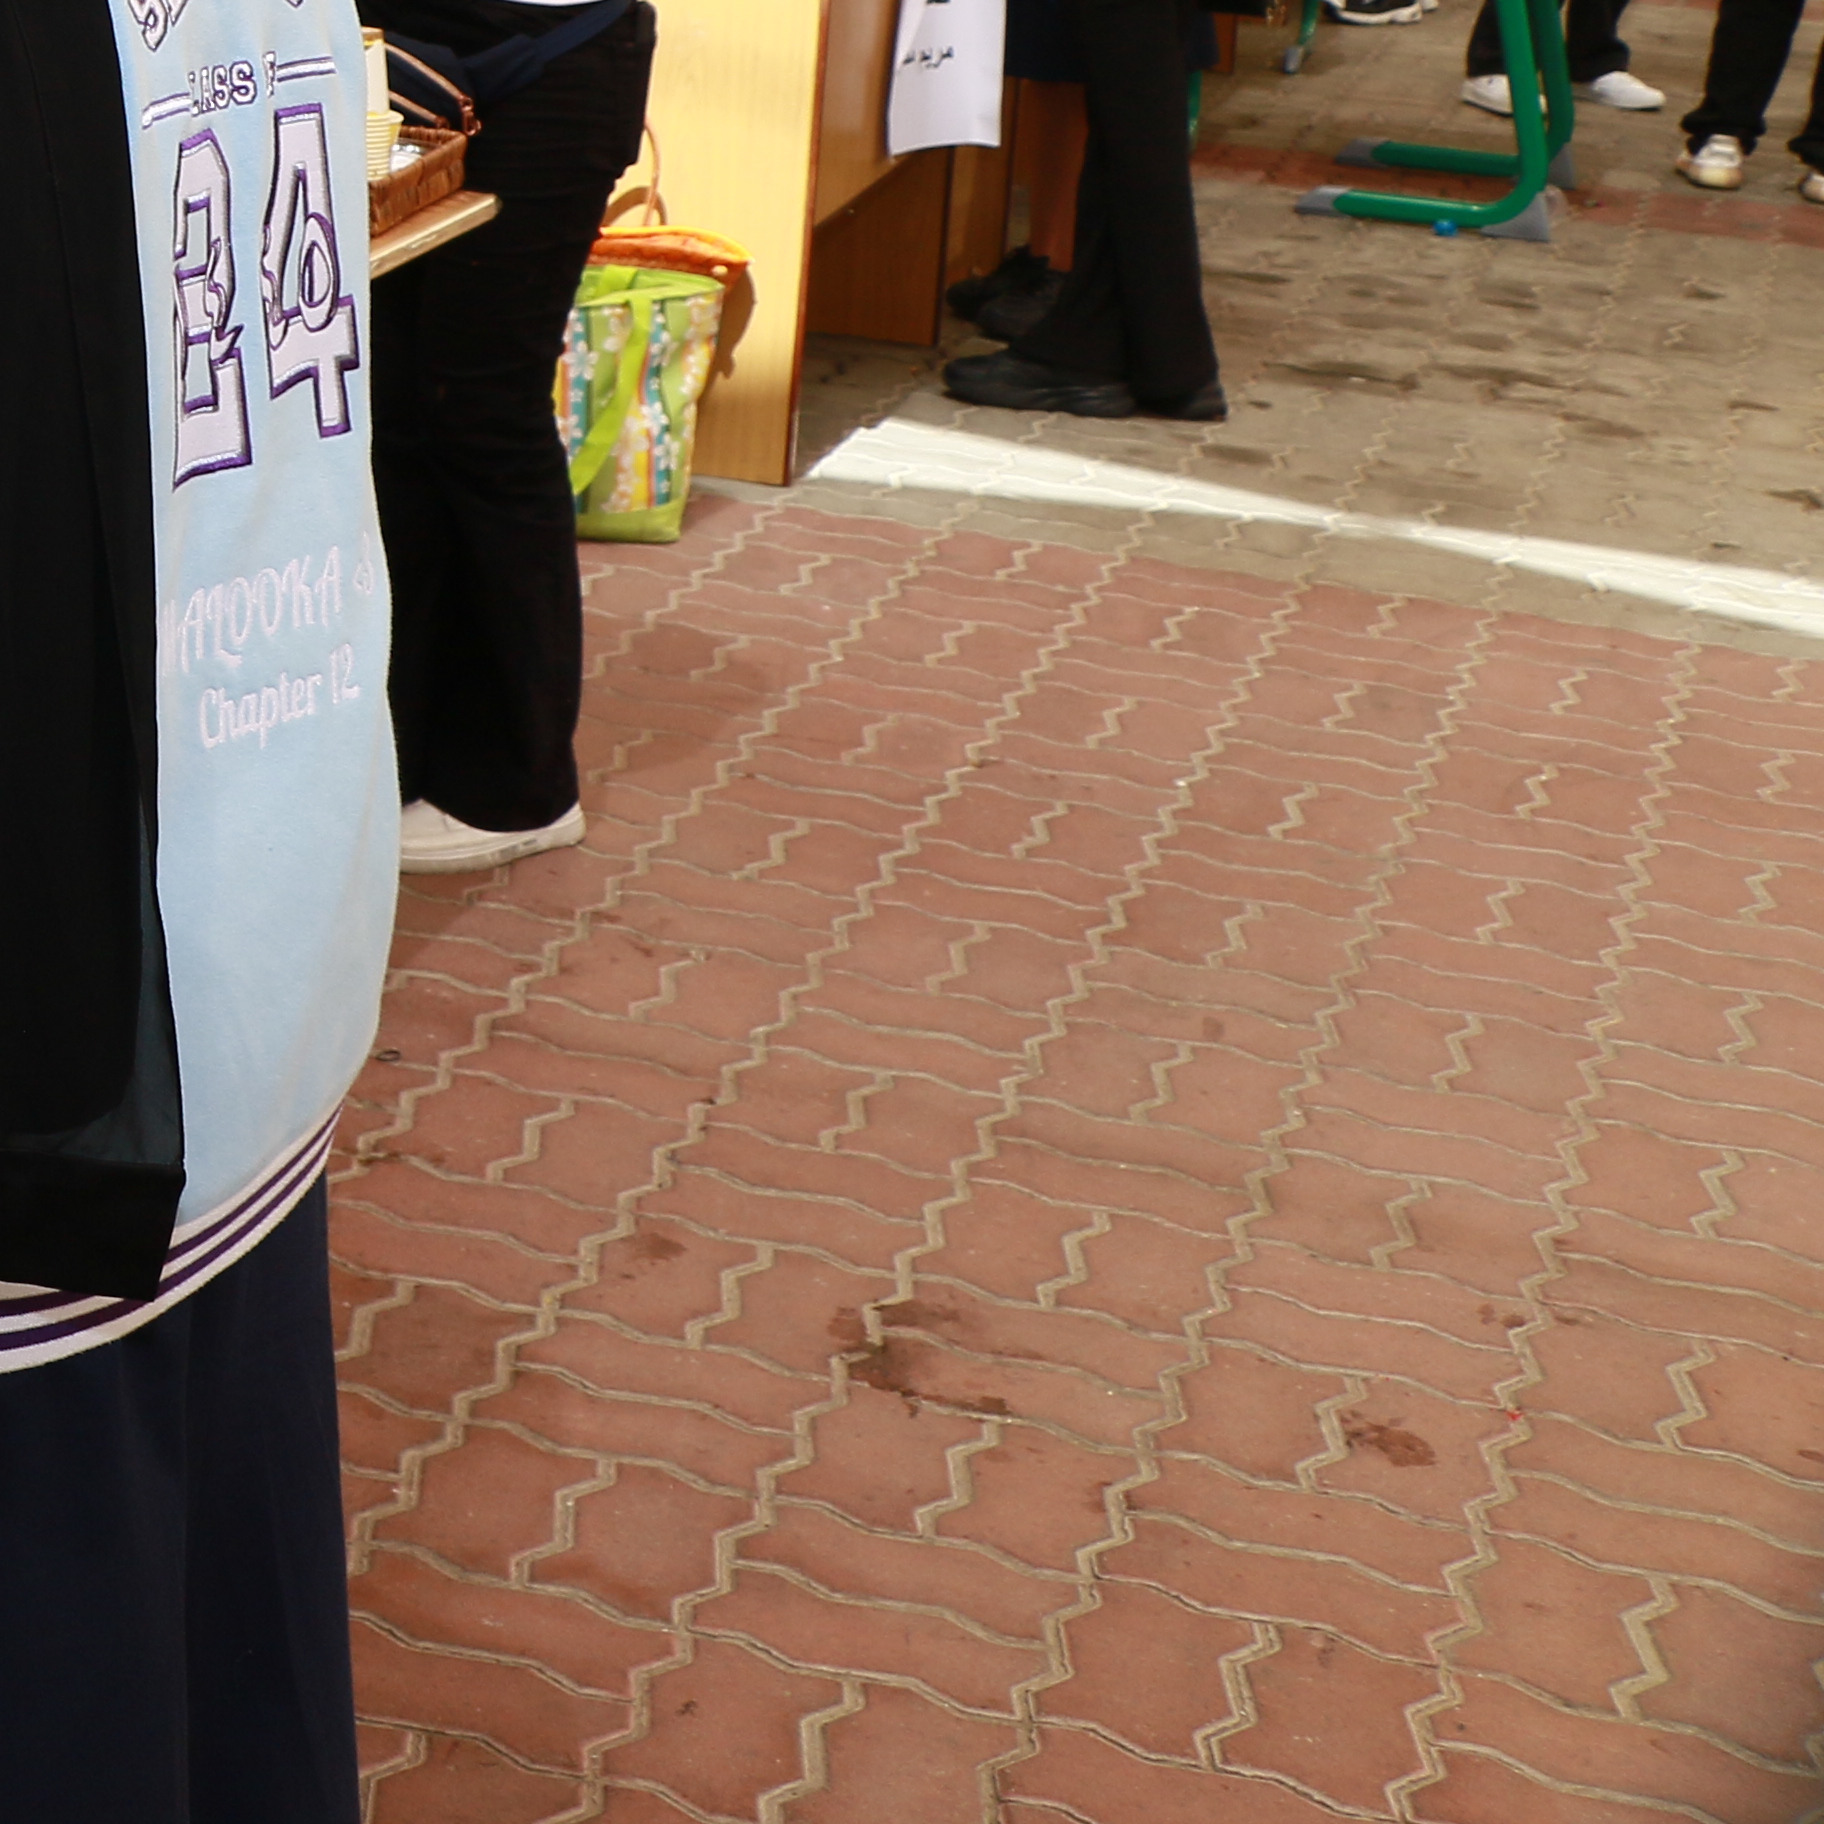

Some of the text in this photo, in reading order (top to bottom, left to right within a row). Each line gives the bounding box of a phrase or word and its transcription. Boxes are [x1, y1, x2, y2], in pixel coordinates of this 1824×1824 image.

[186, 60, 258, 117] LASS
[199, 642, 362, 750] Chapter 12
